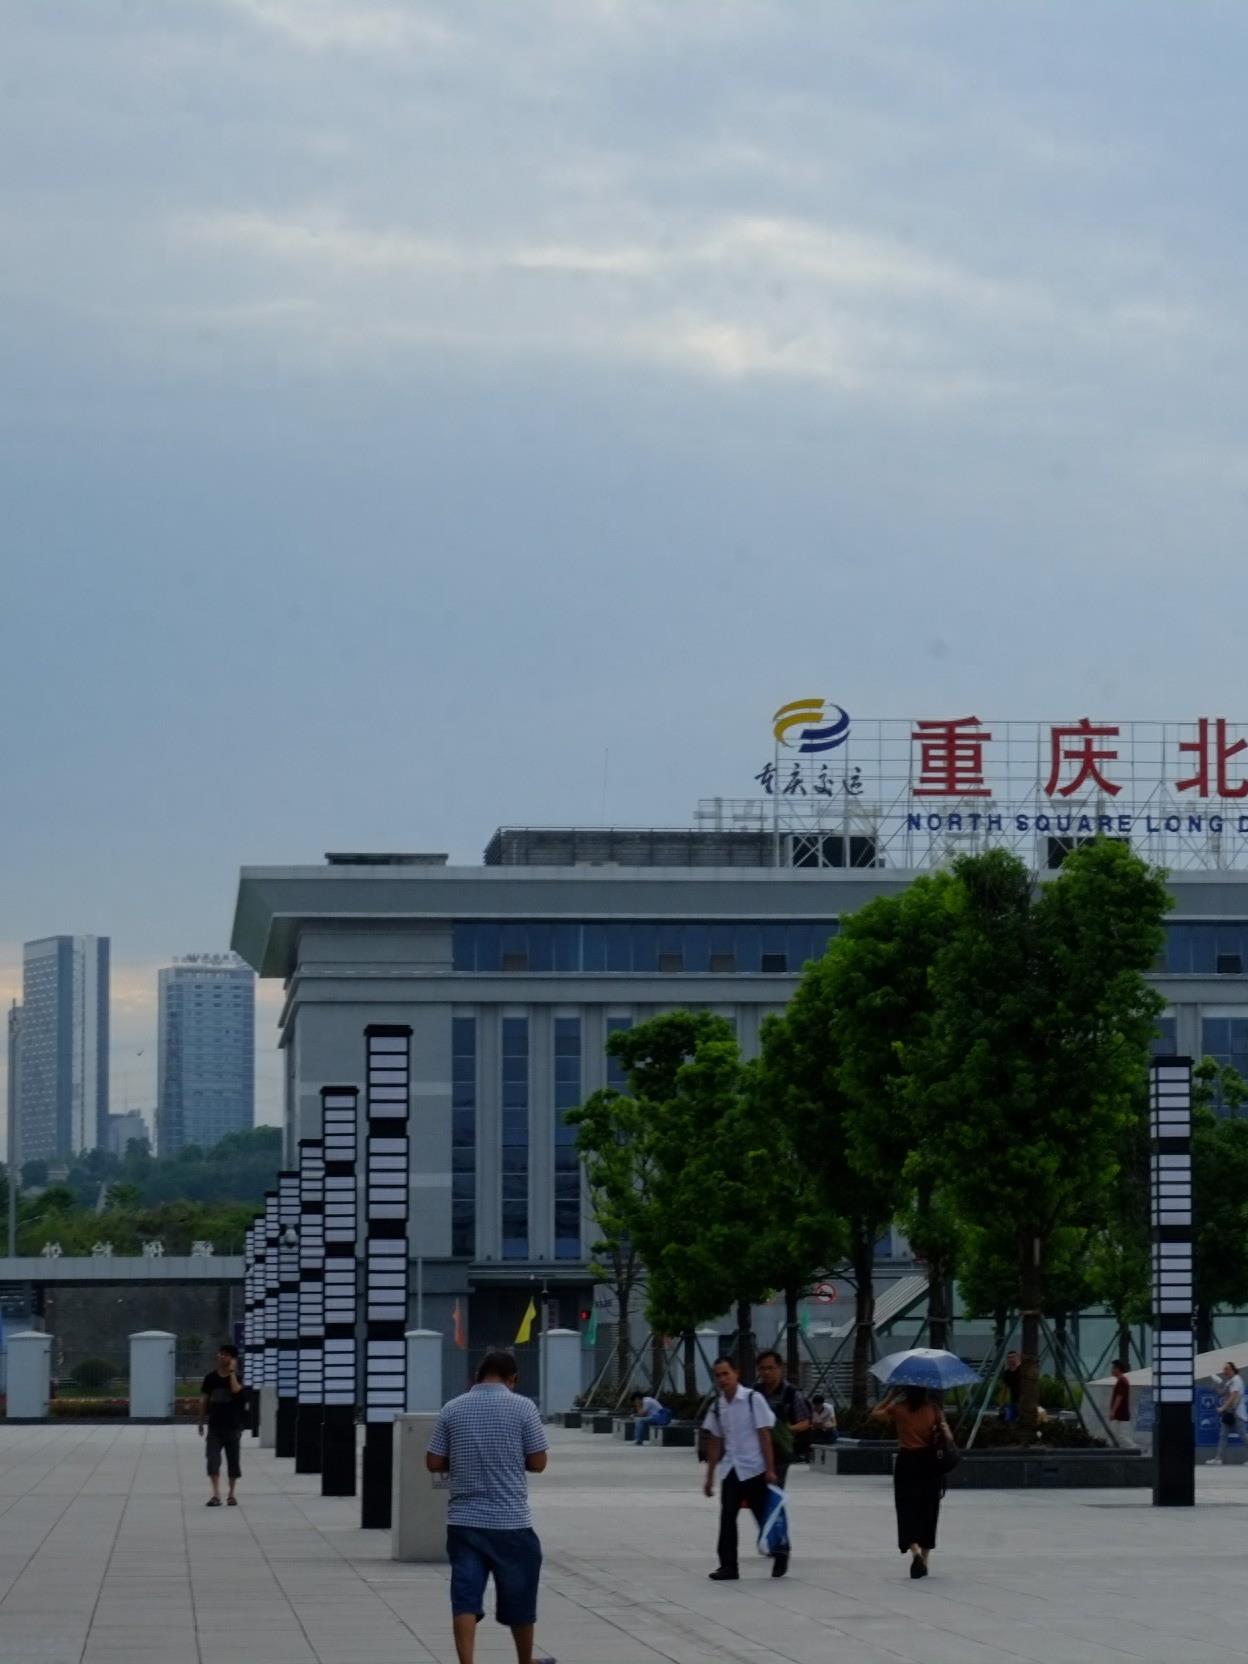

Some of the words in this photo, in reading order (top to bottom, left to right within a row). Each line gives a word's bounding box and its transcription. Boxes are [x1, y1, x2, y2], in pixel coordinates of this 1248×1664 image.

[754, 762, 864, 797] 重庆交运
[906, 814, 1003, 832] NORTH
[1014, 814, 1132, 833] SQUARE
[1145, 815, 1224, 833] LONG
